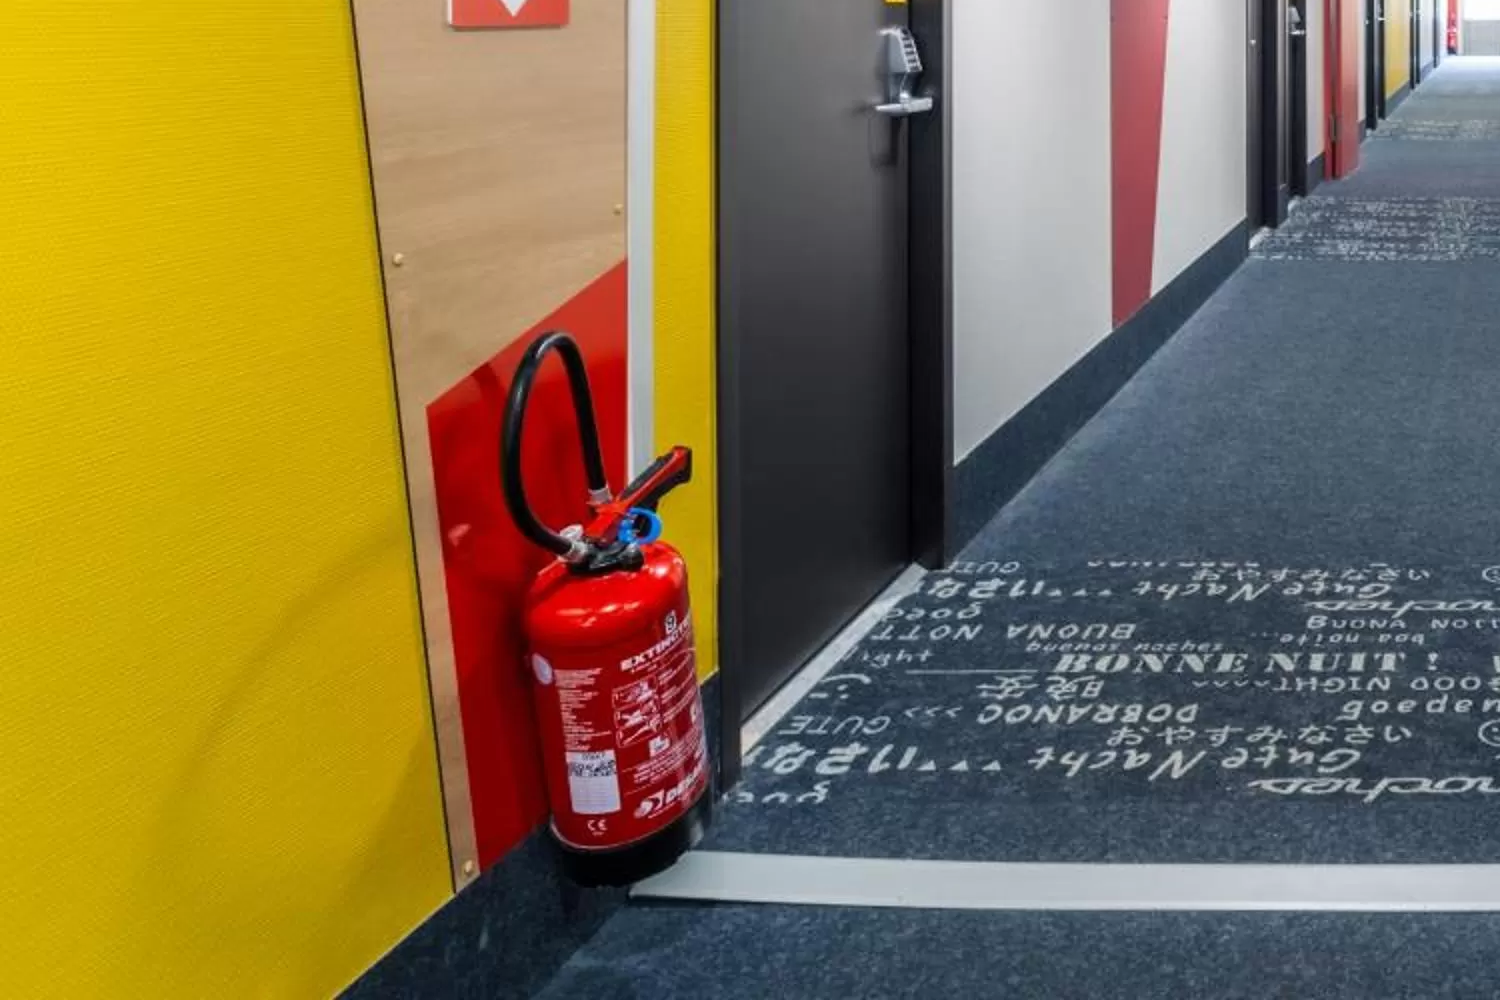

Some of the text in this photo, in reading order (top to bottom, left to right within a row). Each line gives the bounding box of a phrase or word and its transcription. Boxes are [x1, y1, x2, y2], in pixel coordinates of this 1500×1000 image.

[1131, 580, 1392, 603] Gute Nacht
[1006, 623, 1137, 641] BUONA
[1052, 651, 1248, 674] BONNE
[1266, 651, 1408, 673] NUIT
[778, 714, 892, 735] GUTE
[976, 703, 1200, 725] DOBRANOC
[1027, 747, 1361, 781] Gute Nacht
